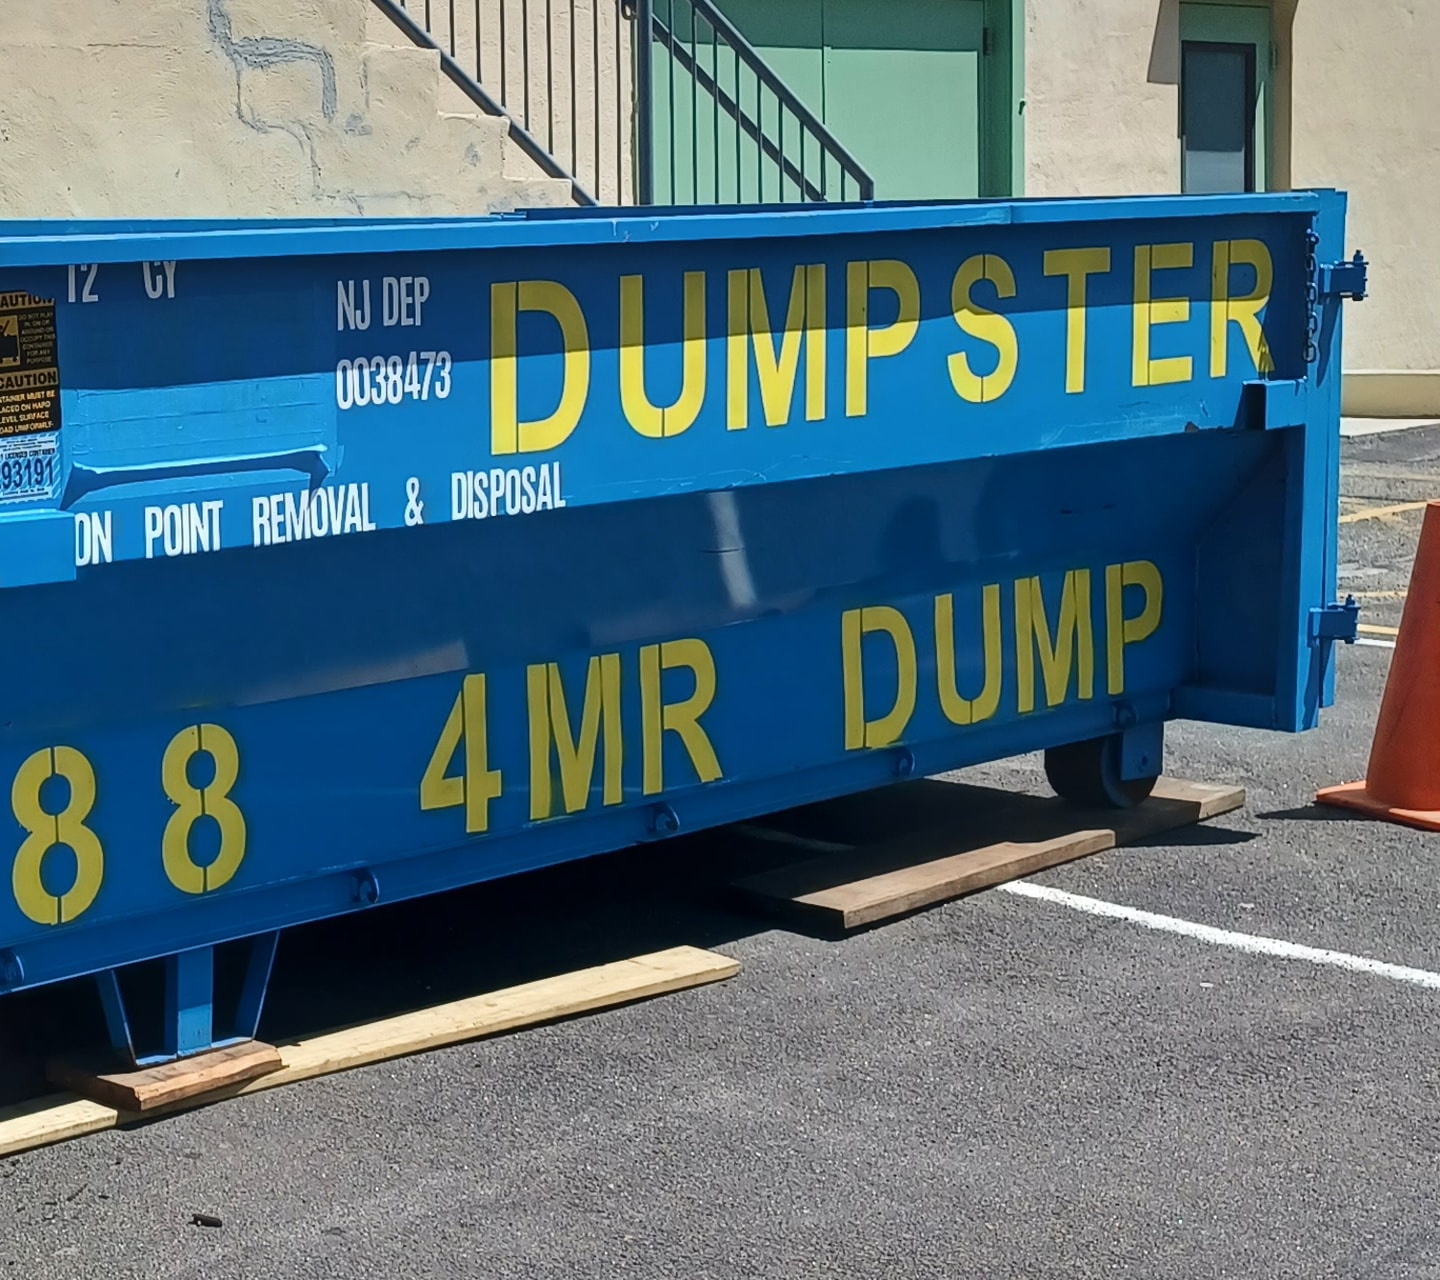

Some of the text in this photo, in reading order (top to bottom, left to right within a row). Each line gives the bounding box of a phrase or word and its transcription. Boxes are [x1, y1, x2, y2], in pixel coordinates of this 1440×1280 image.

[337, 276, 430, 331] NJ DEP
[489, 239, 1276, 456] DUMPSTER
[336, 351, 452, 410] 0038473
[75, 462, 566, 566] ON POINT REMOVAL & DISPOSAL
[841, 560, 1164, 751] DUMP
